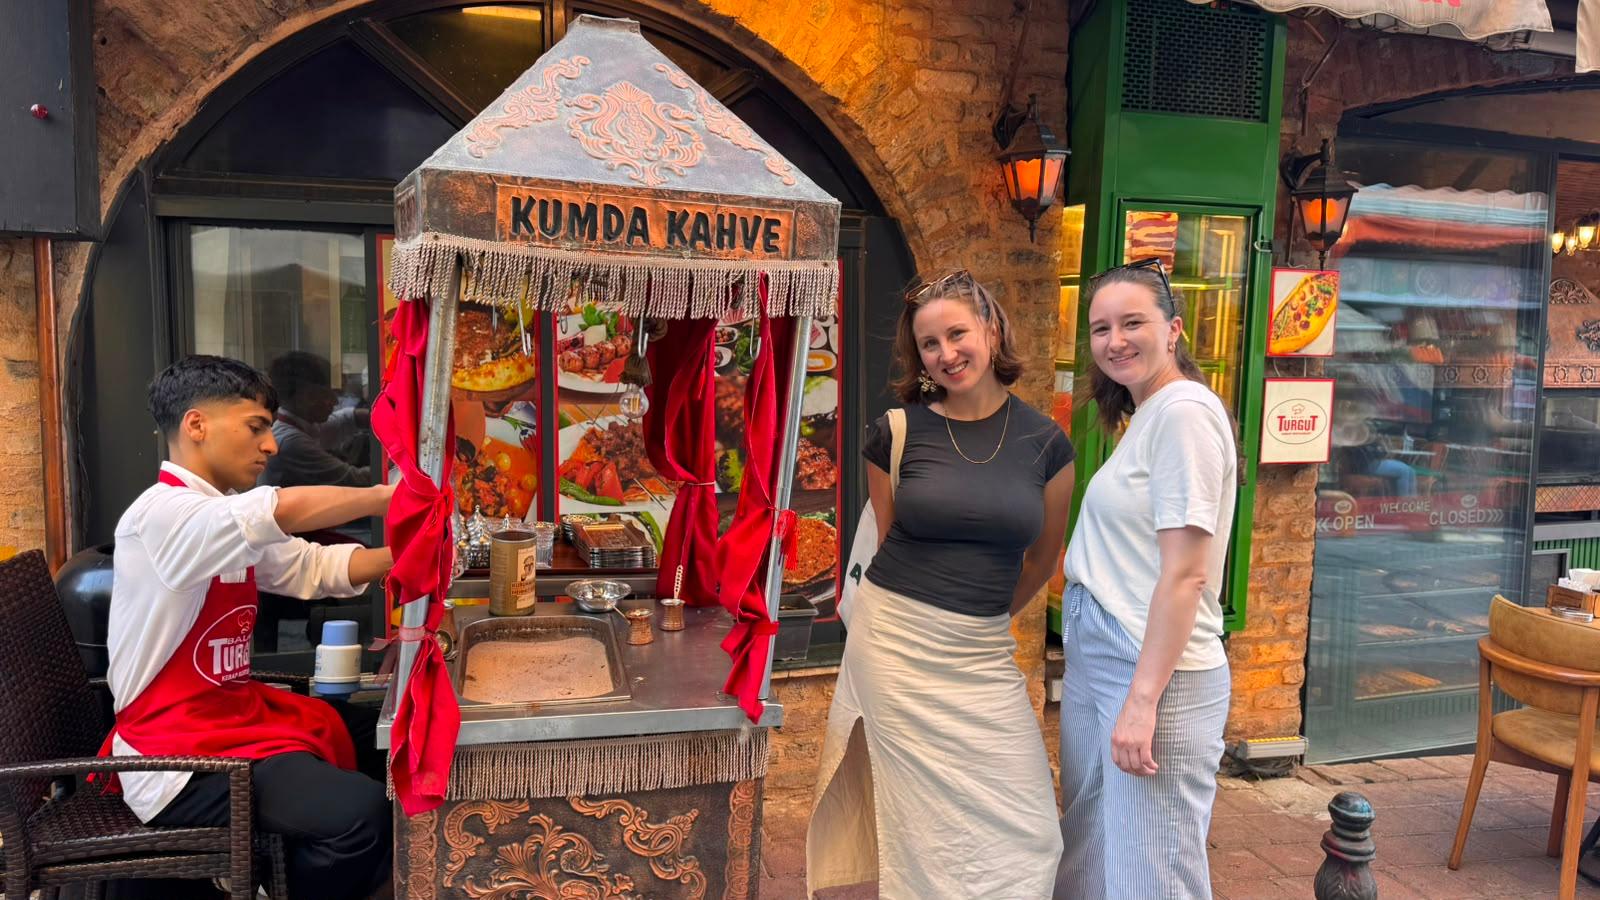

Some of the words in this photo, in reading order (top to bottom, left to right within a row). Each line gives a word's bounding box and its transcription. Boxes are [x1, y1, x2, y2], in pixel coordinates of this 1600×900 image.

[510, 195, 650, 247] KUMDA
[666, 209, 782, 253] KAHVE
[1277, 415, 1318, 432] TURGUT
[1380, 500, 1431, 514] WELCOME
[1333, 514, 1375, 531] OPEN
[1429, 509, 1486, 526] CLOSED
